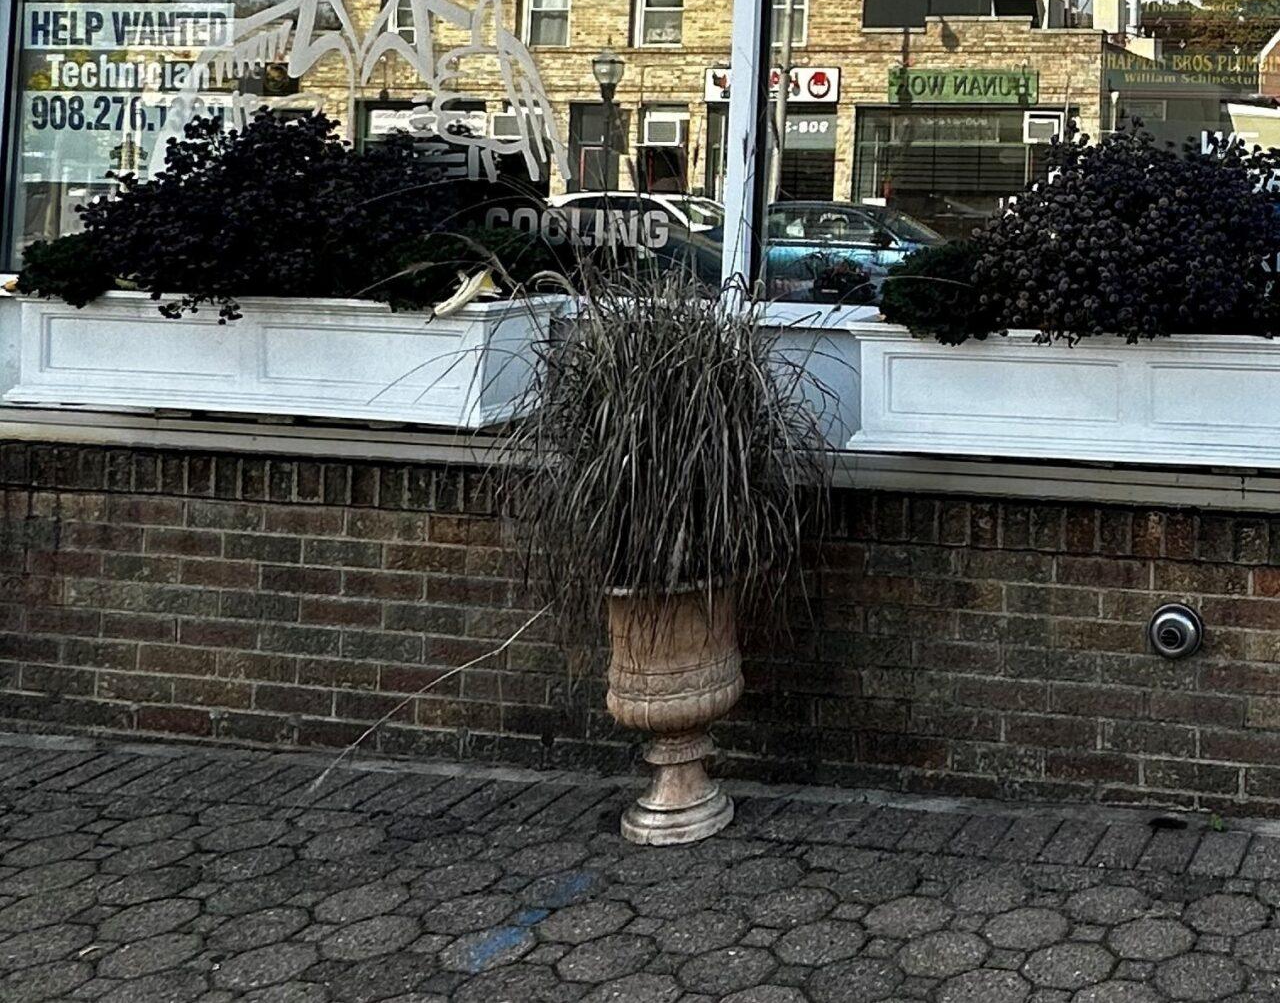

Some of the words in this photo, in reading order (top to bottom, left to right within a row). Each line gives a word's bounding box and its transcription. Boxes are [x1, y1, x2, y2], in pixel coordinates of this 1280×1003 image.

[31, 10, 104, 46] HELP
[112, 10, 227, 46] WANTED
[46, 53, 210, 89] Technician
[1172, 53, 1213, 72] BROS
[486, 207, 670, 249] COOLING
